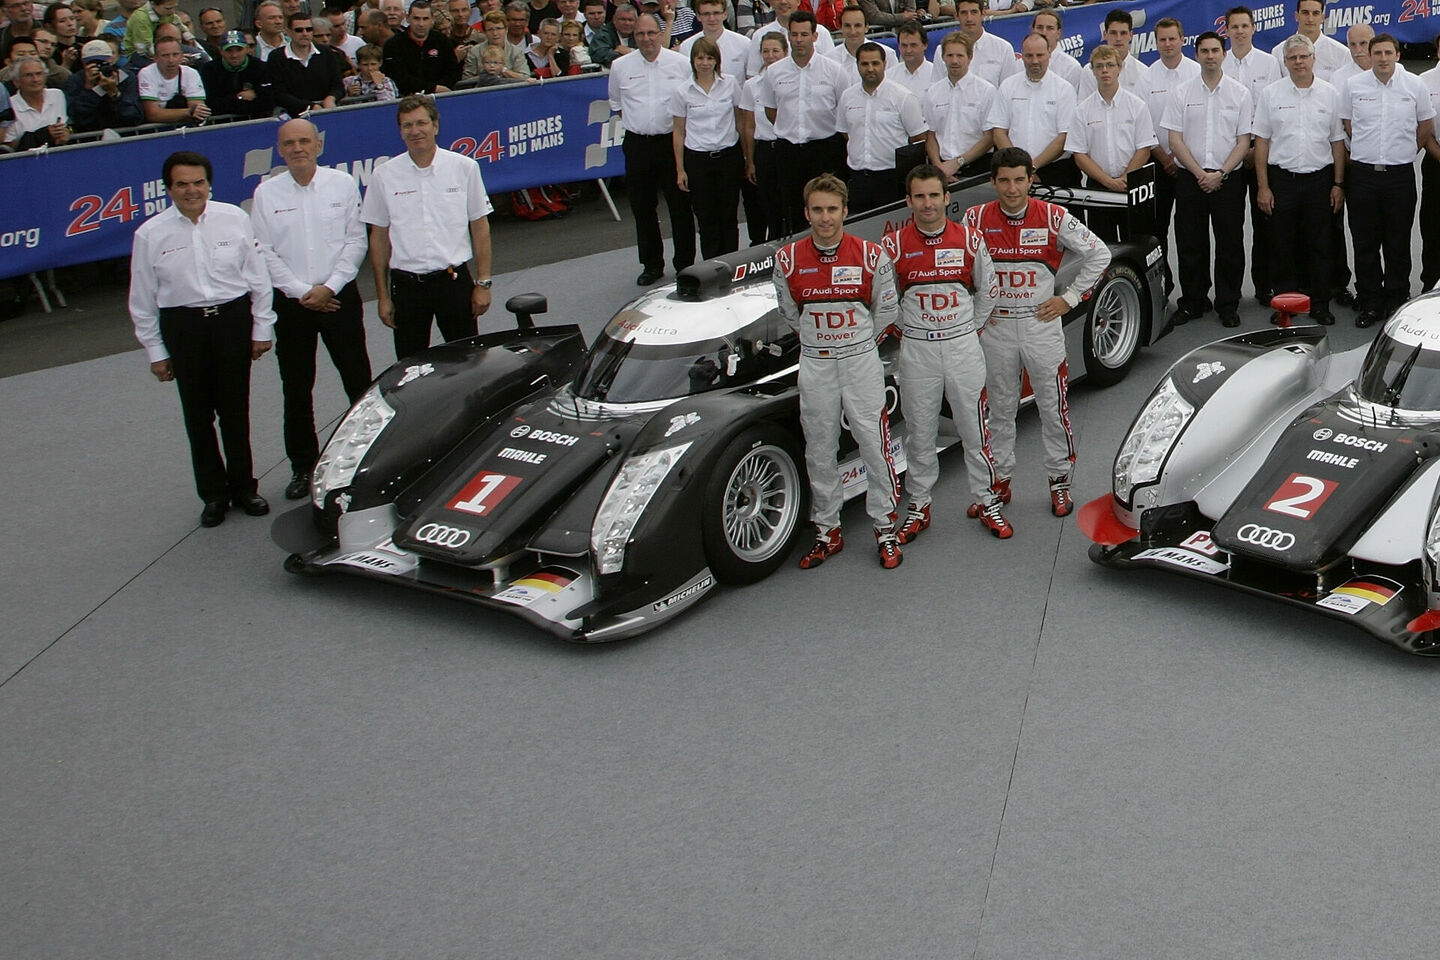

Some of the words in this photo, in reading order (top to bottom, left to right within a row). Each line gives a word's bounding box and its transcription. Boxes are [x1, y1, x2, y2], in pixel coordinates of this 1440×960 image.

[1264, 15, 1285, 31] MANS
[450, 130, 505, 165] 24
[508, 115, 563, 143] HEURES
[509, 141, 527, 158] DU
[531, 132, 564, 152] MANS
[1129, 181, 1155, 206] TDI
[65, 186, 139, 238] 24
[144, 199, 167, 218] DU
[1019, 248, 1042, 256] Sport
[748, 255, 773, 275] Audi
[939, 268, 962, 278] Sport
[995, 271, 1037, 288] TDI
[833, 287, 859, 296] Sport
[1000, 290, 1035, 299] Power
[915, 291, 960, 311] TDI
[808, 308, 857, 329] TDI
[921, 312, 958, 323] Power
[643, 326, 678, 336] ultra
[816, 331, 856, 341] Power
[1398, 324, 1427, 337] Audi
[528, 429, 580, 447] BOSCH
[1333, 433, 1388, 453] BOSCH
[497, 447, 547, 465] MAHLE
[1306, 449, 1360, 469] MAHLE
[842, 466, 858, 485] 24
[452, 474, 507, 514] 1
[1268, 476, 1325, 518] 2
[353, 553, 394, 569] MANS
[1162, 550, 1205, 567] MANS
[667, 577, 711, 606] MICHELIN
